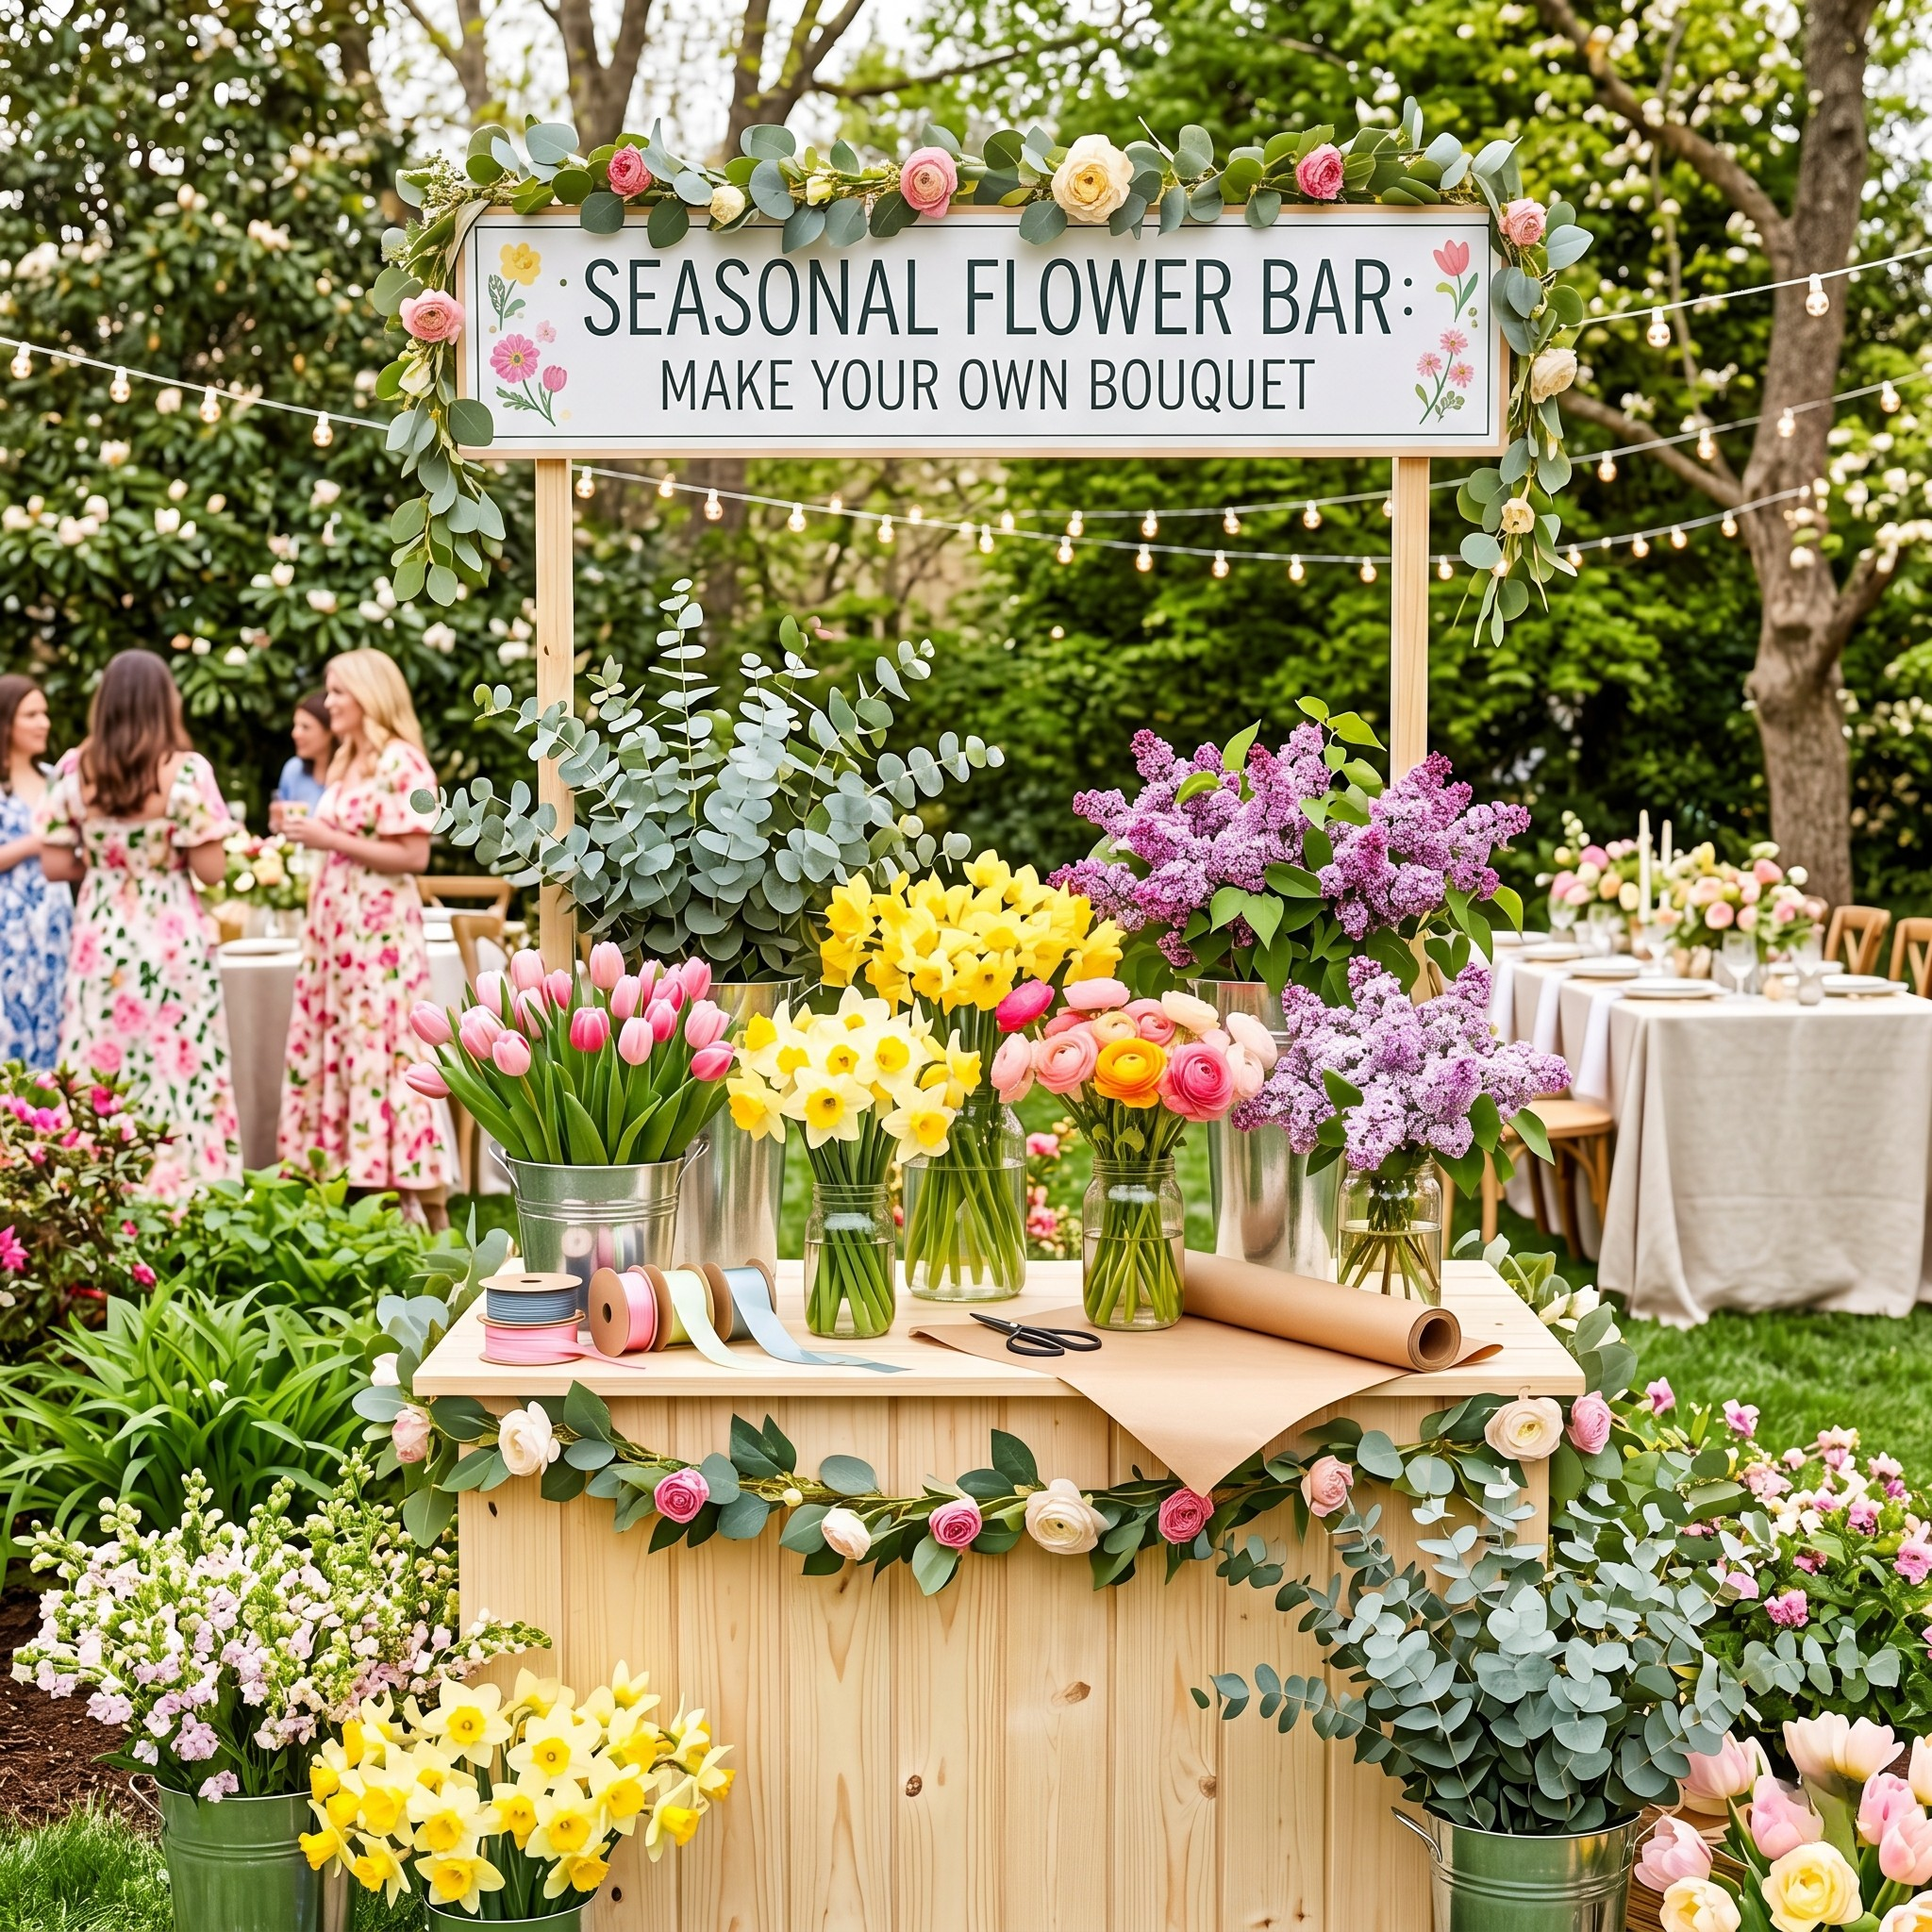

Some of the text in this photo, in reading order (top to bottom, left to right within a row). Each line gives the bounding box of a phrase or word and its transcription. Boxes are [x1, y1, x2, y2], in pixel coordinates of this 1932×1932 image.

[584, 258, 1413, 337] SEASONAL FLOWER BAR:
[662, 358, 1316, 413] MAKE YOUR OWN BOUQUET
